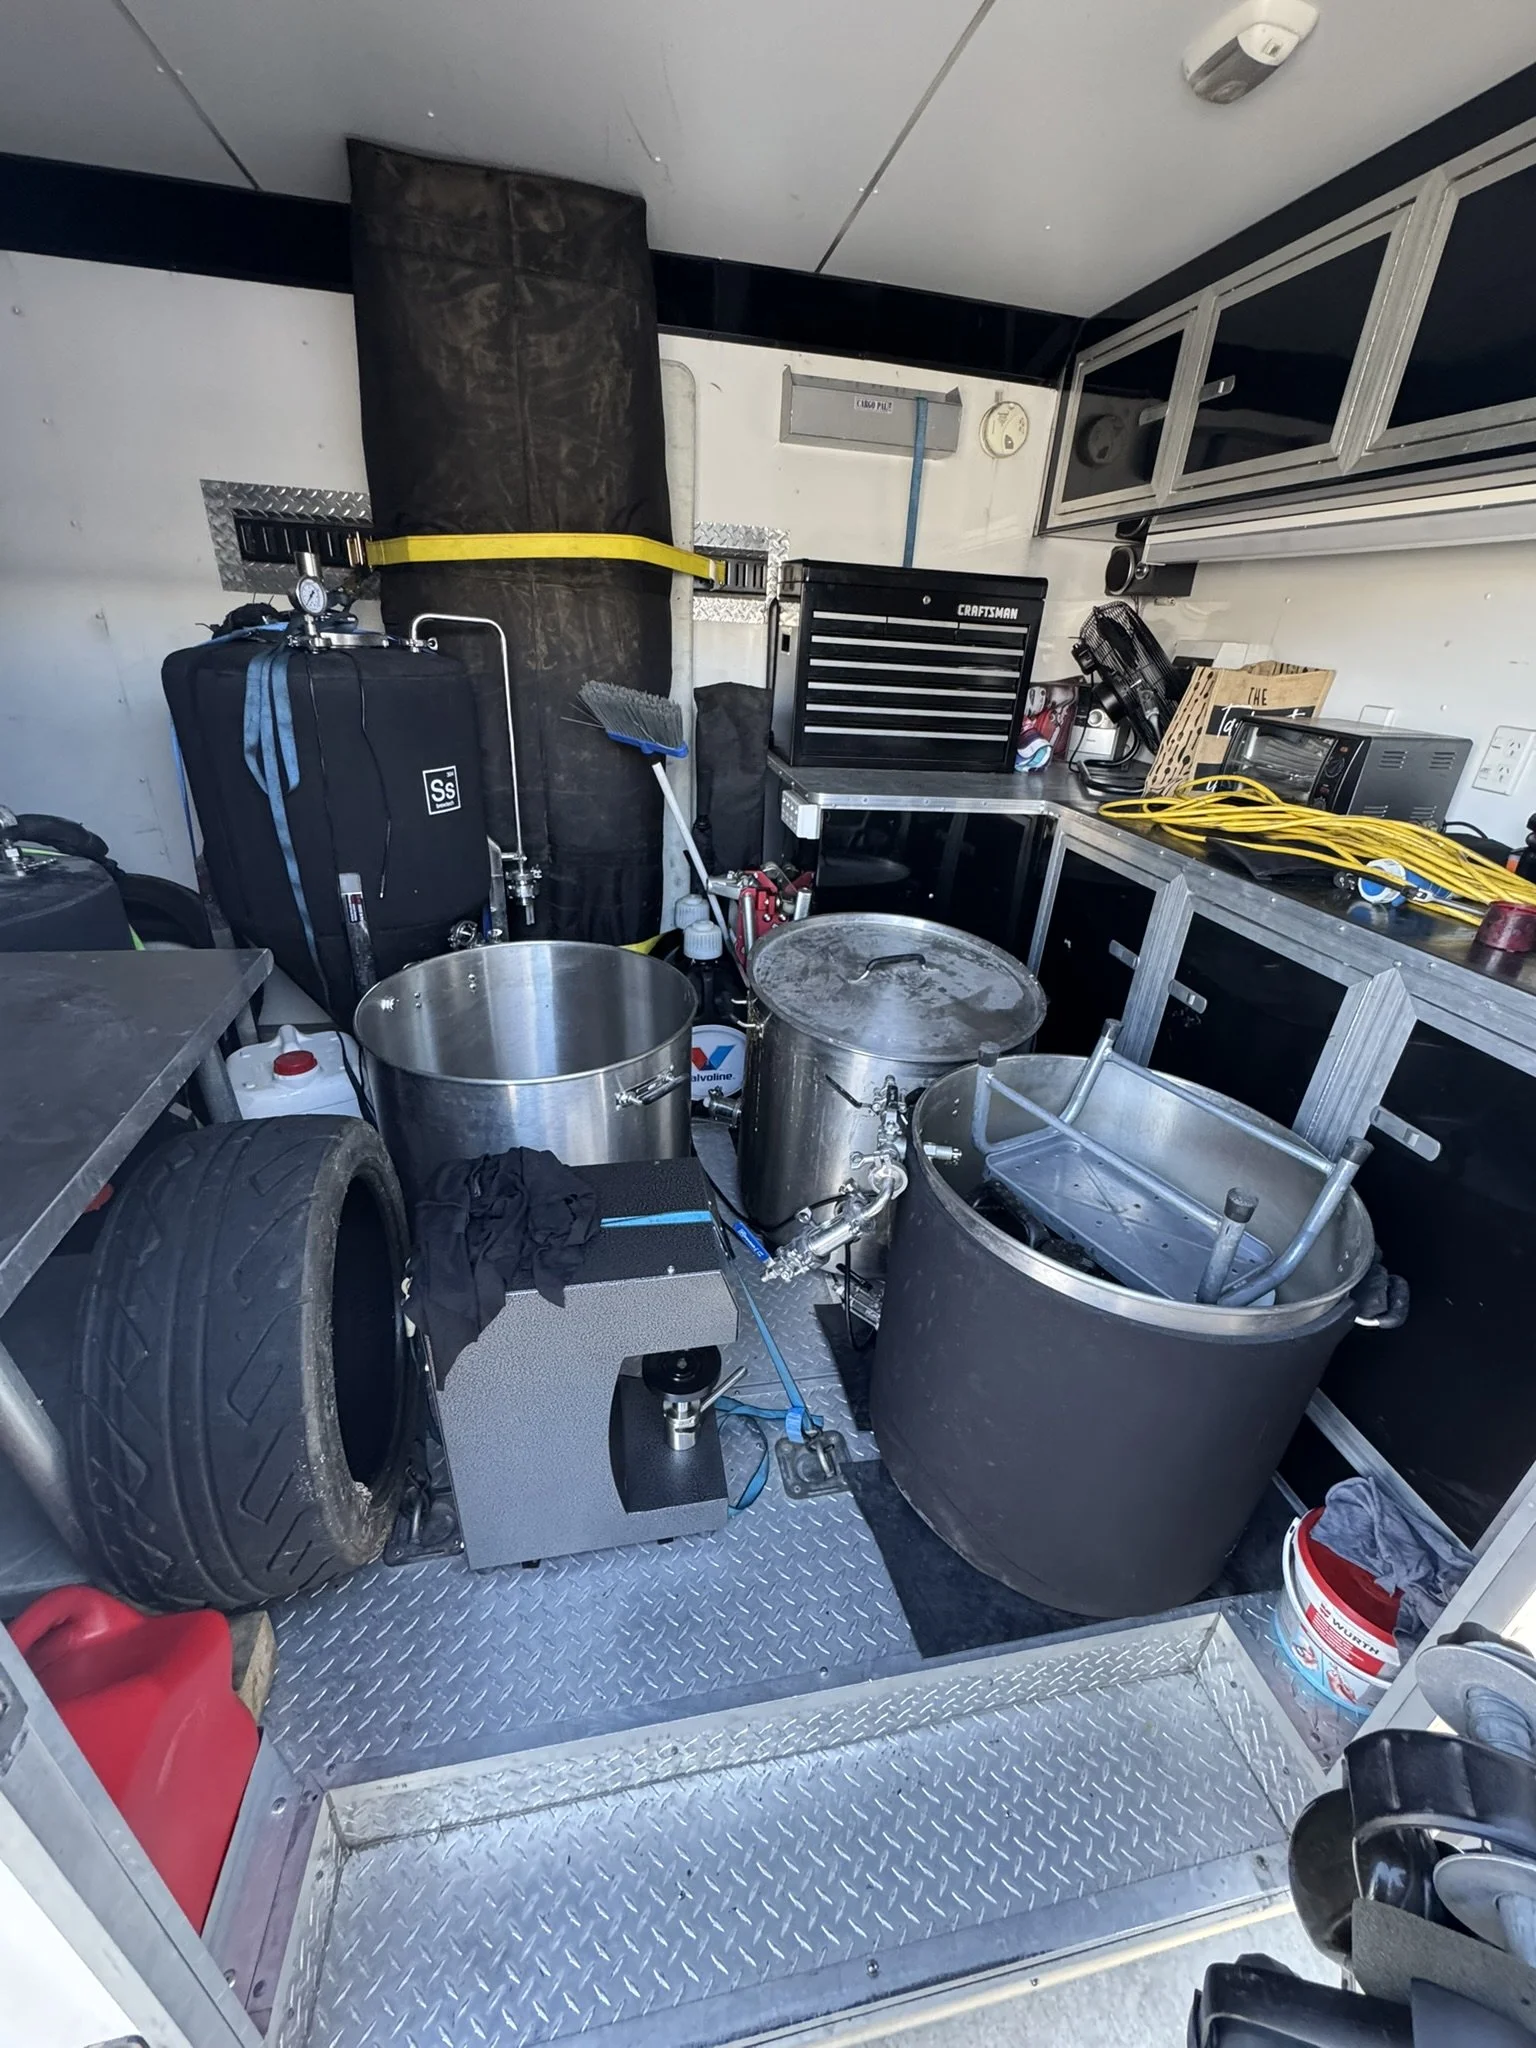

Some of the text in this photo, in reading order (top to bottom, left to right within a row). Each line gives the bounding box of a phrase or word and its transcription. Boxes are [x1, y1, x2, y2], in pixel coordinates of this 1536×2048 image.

[957, 604, 1019, 620] CRAFTSMAN
[1247, 686, 1269, 707] THE
[430, 779, 456, 802] Ss
[691, 1073, 733, 1082] alvoline
